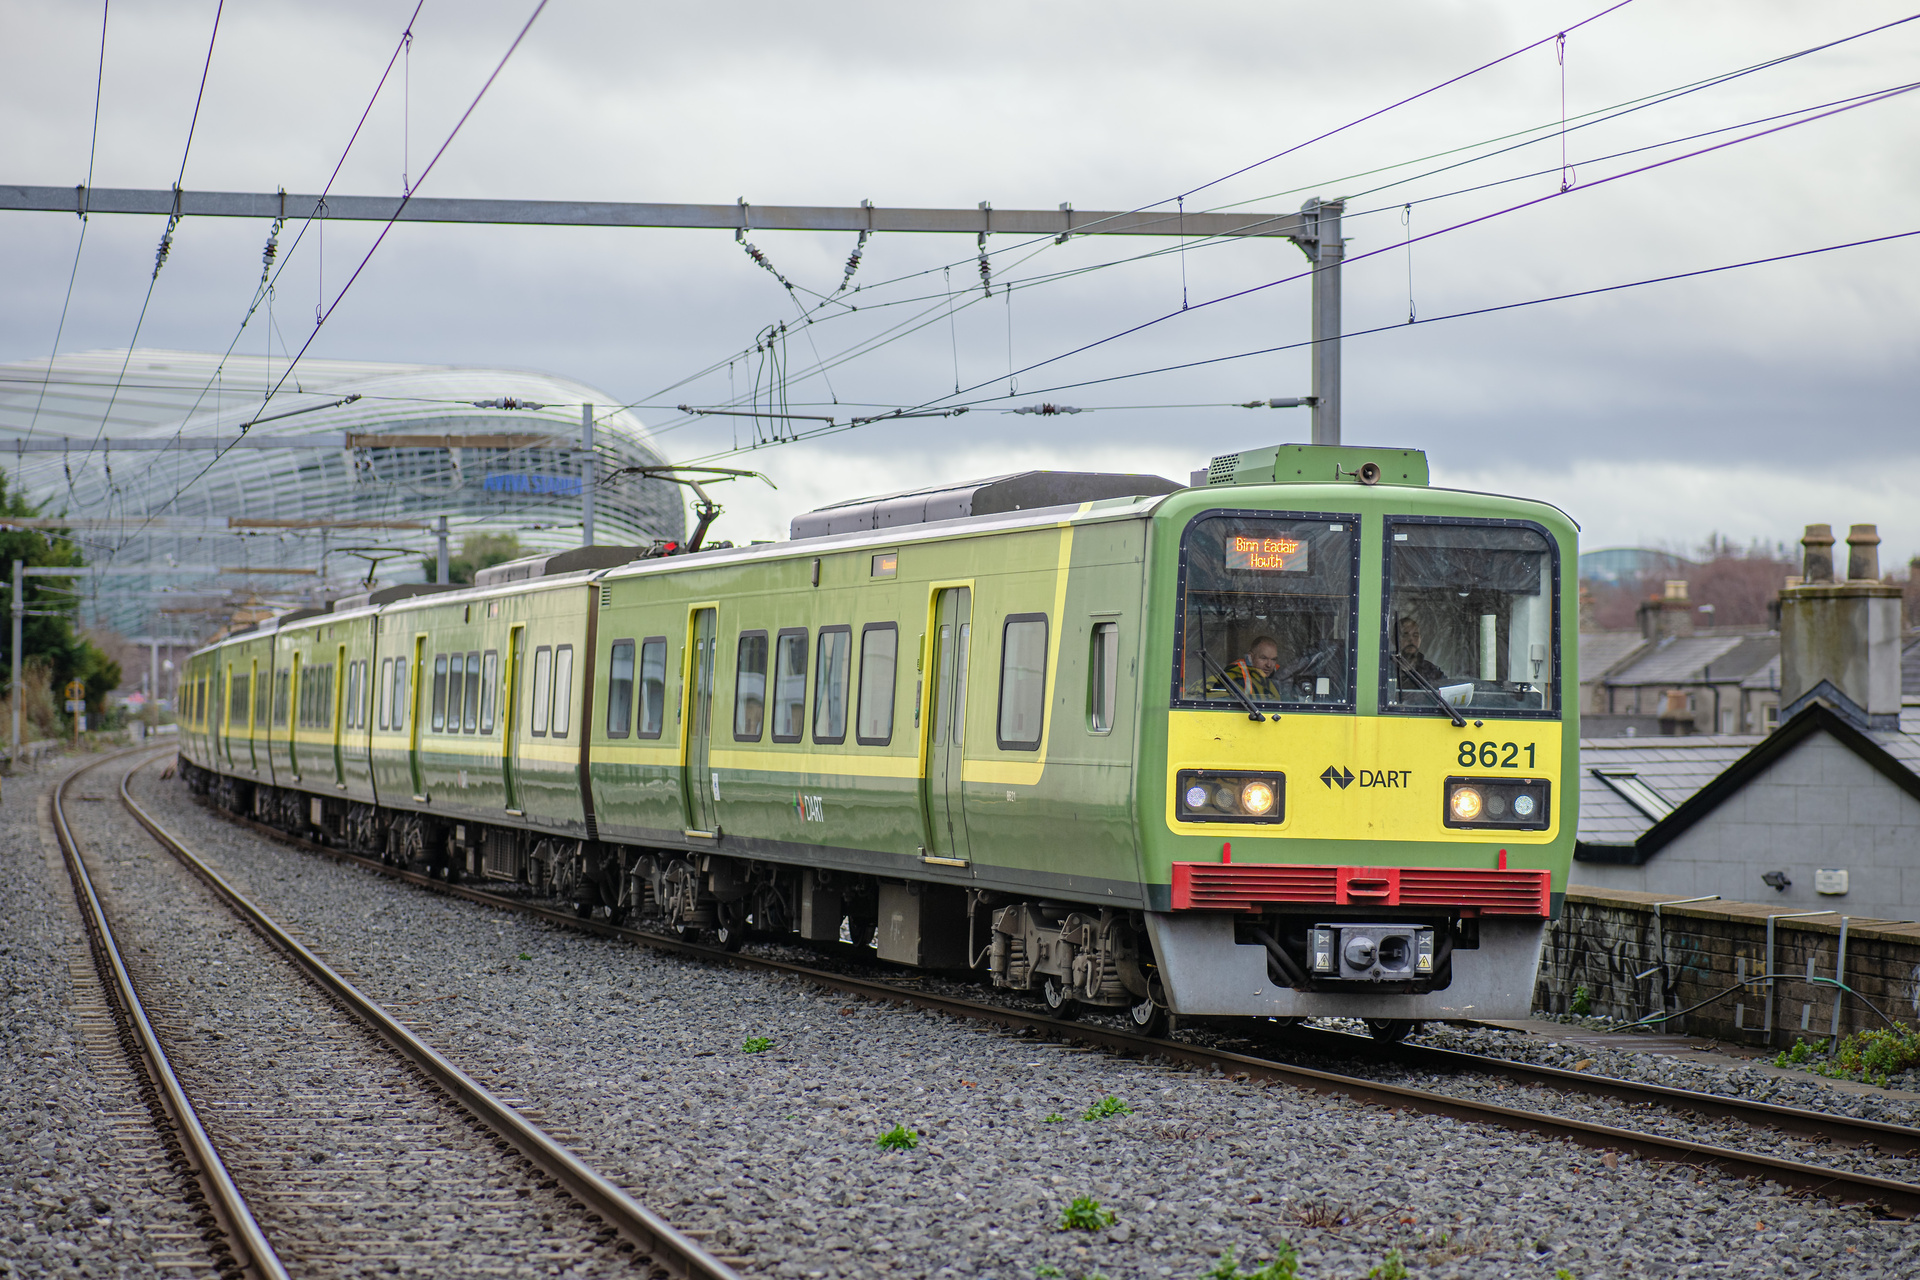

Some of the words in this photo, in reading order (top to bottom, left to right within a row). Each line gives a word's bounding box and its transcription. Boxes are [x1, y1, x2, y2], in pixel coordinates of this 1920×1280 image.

[483, 472, 531, 493] AVIVA
[1236, 536, 1259, 552] Binn
[1250, 553, 1283, 569] Howth
[1457, 740, 1536, 769] 8621
[1359, 769, 1412, 788] DART
[804, 795, 824, 822] DART
